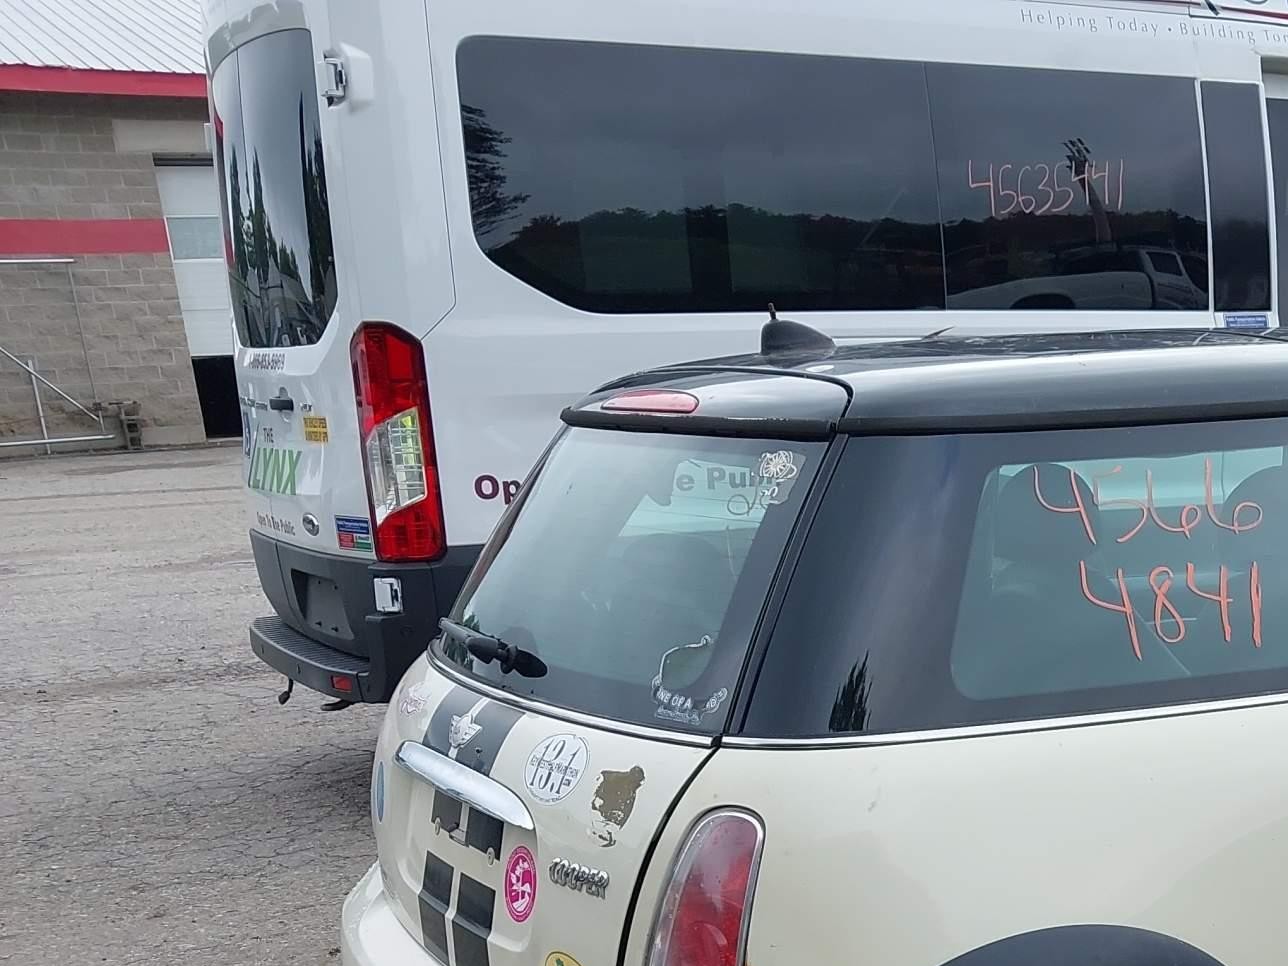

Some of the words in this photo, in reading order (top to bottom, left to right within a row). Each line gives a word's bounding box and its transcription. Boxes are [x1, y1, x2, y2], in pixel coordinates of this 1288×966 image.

[1020, 8, 1098, 32] Helping
[1106, 16, 1158, 36] Today
[1179, 21, 1256, 45] Building
[968, 159, 1125, 217] 45635441
[251, 447, 302, 495] LYNX
[474, 474, 520, 505] Op
[1078, 559, 1262, 662] 4841
[548, 857, 611, 900] COOPER
